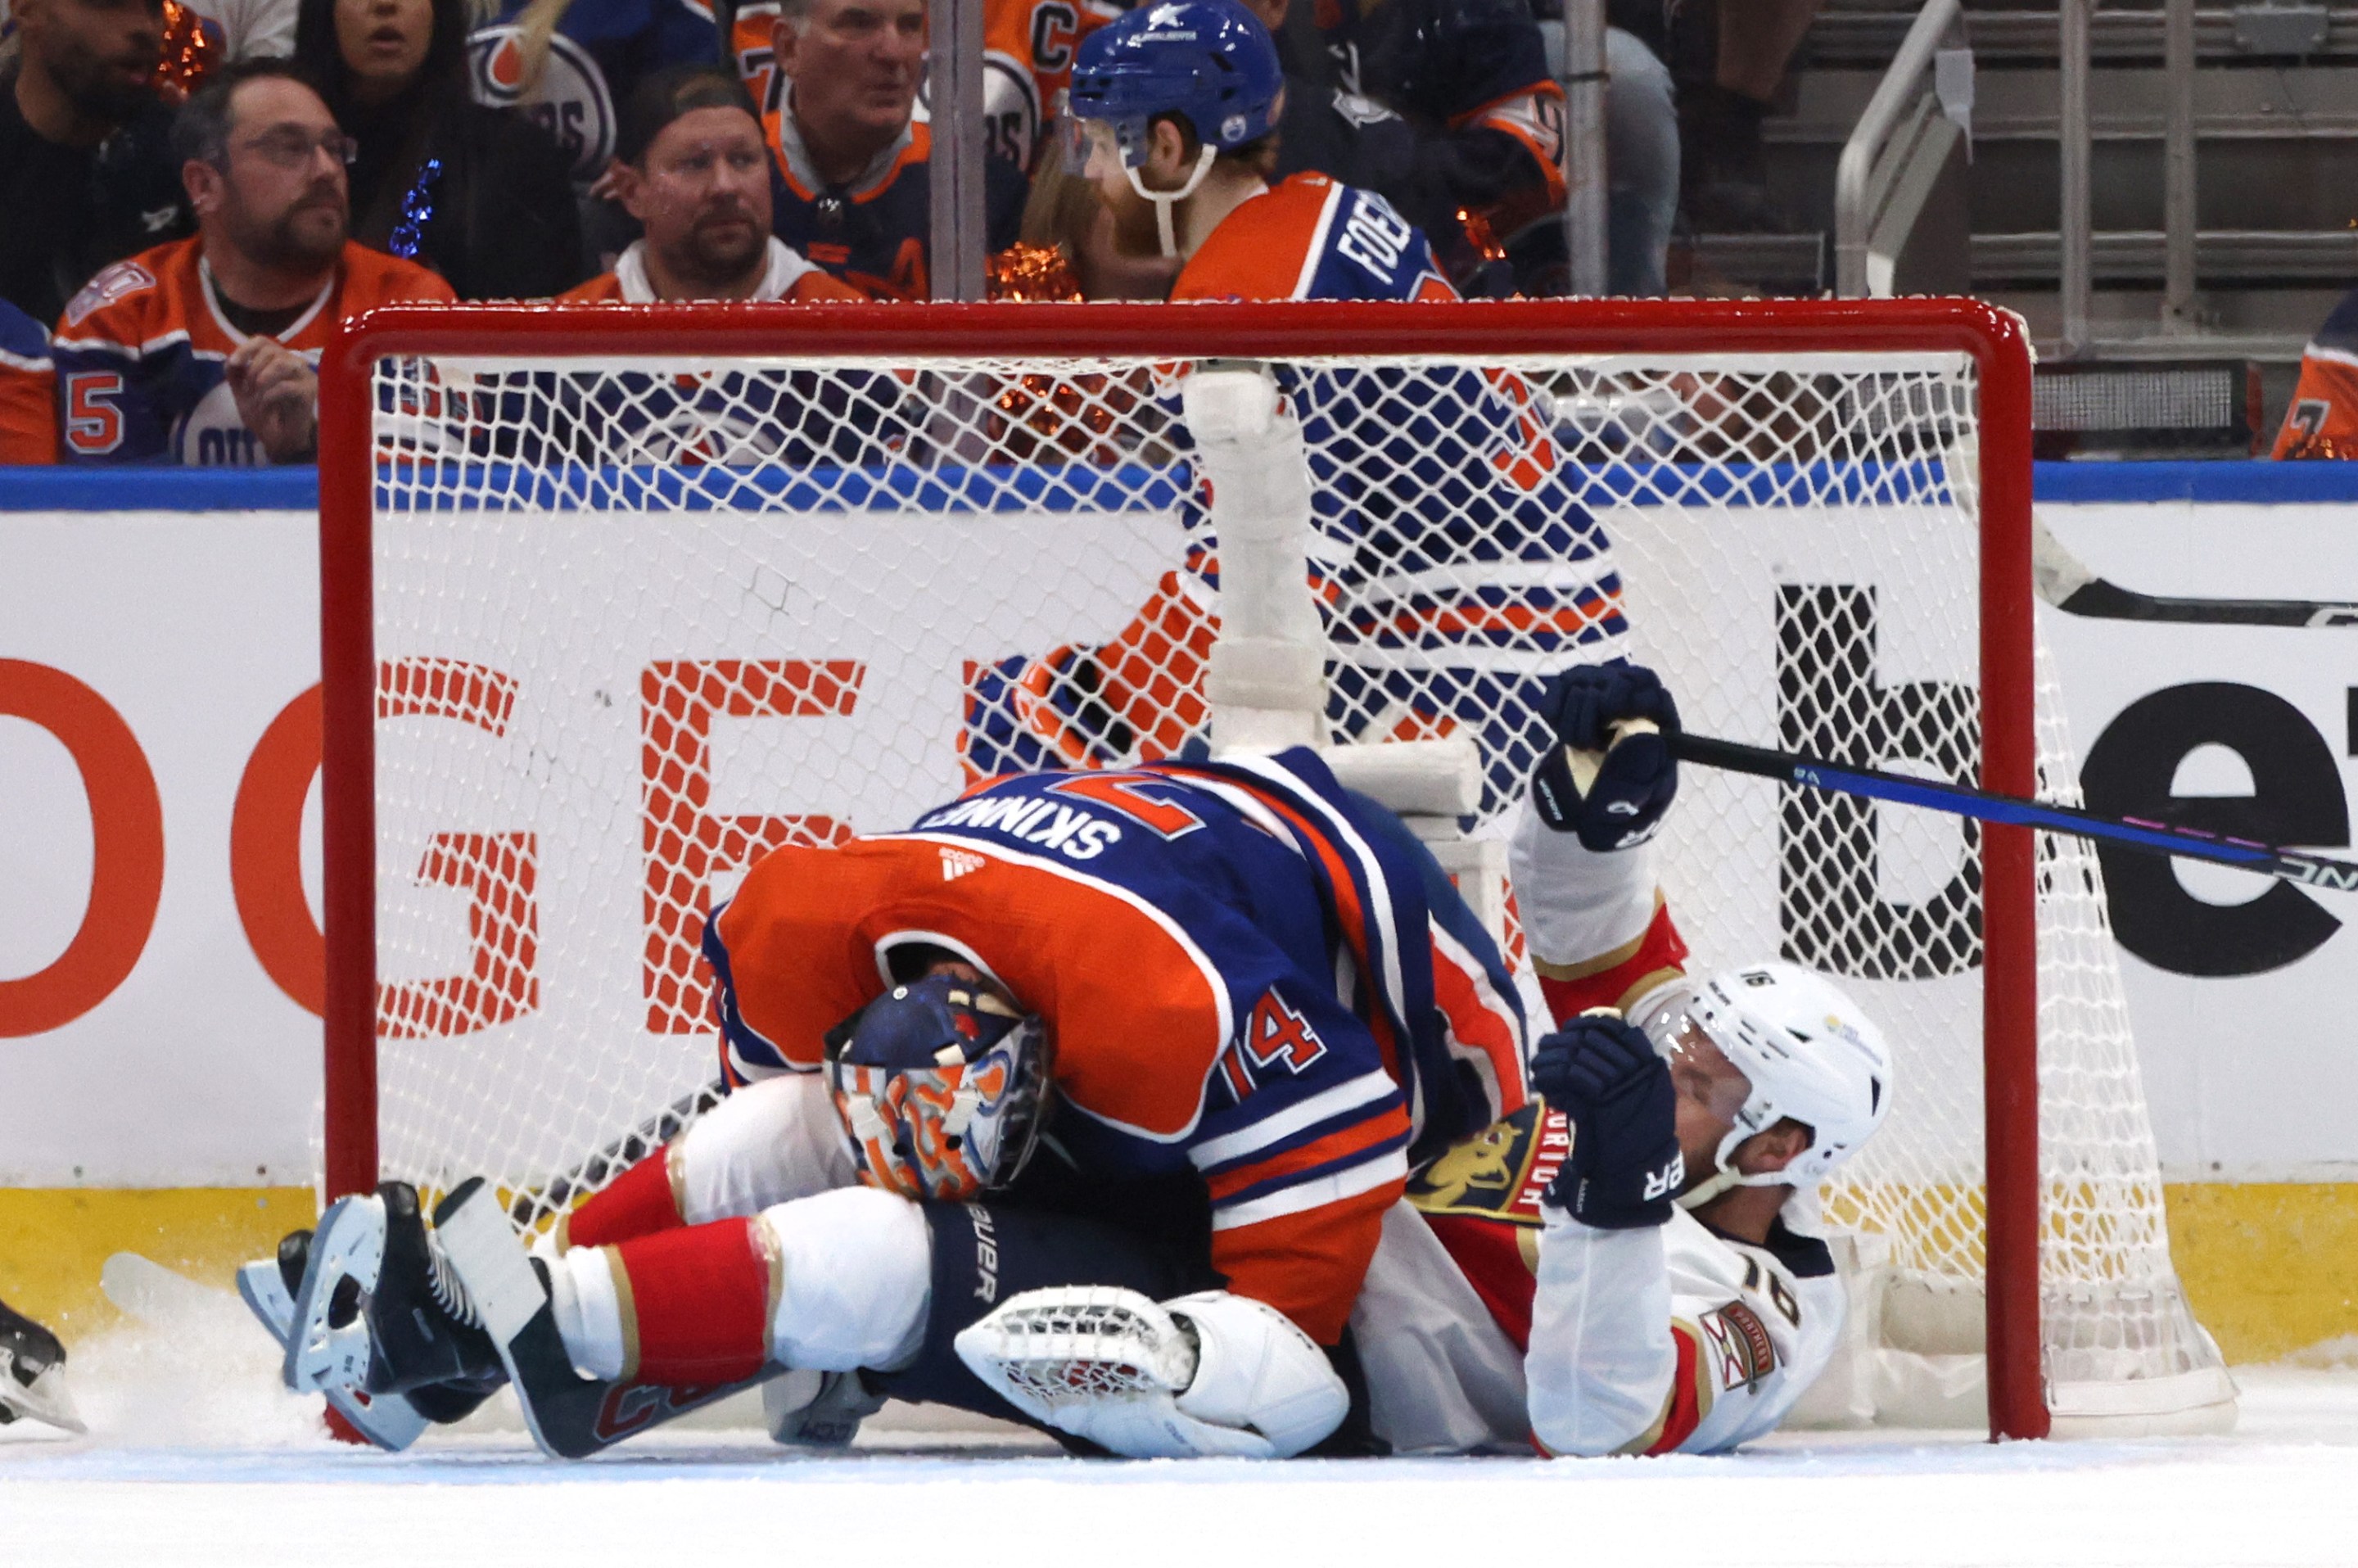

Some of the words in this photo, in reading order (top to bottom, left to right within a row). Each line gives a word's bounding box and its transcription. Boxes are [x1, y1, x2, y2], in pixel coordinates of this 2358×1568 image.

[1030, 2, 1079, 72] C
[1336, 188, 1412, 285] FOE
[66, 371, 123, 455] 5
[1775, 583, 2358, 981] be
[919, 795, 1123, 860] SKINNE
